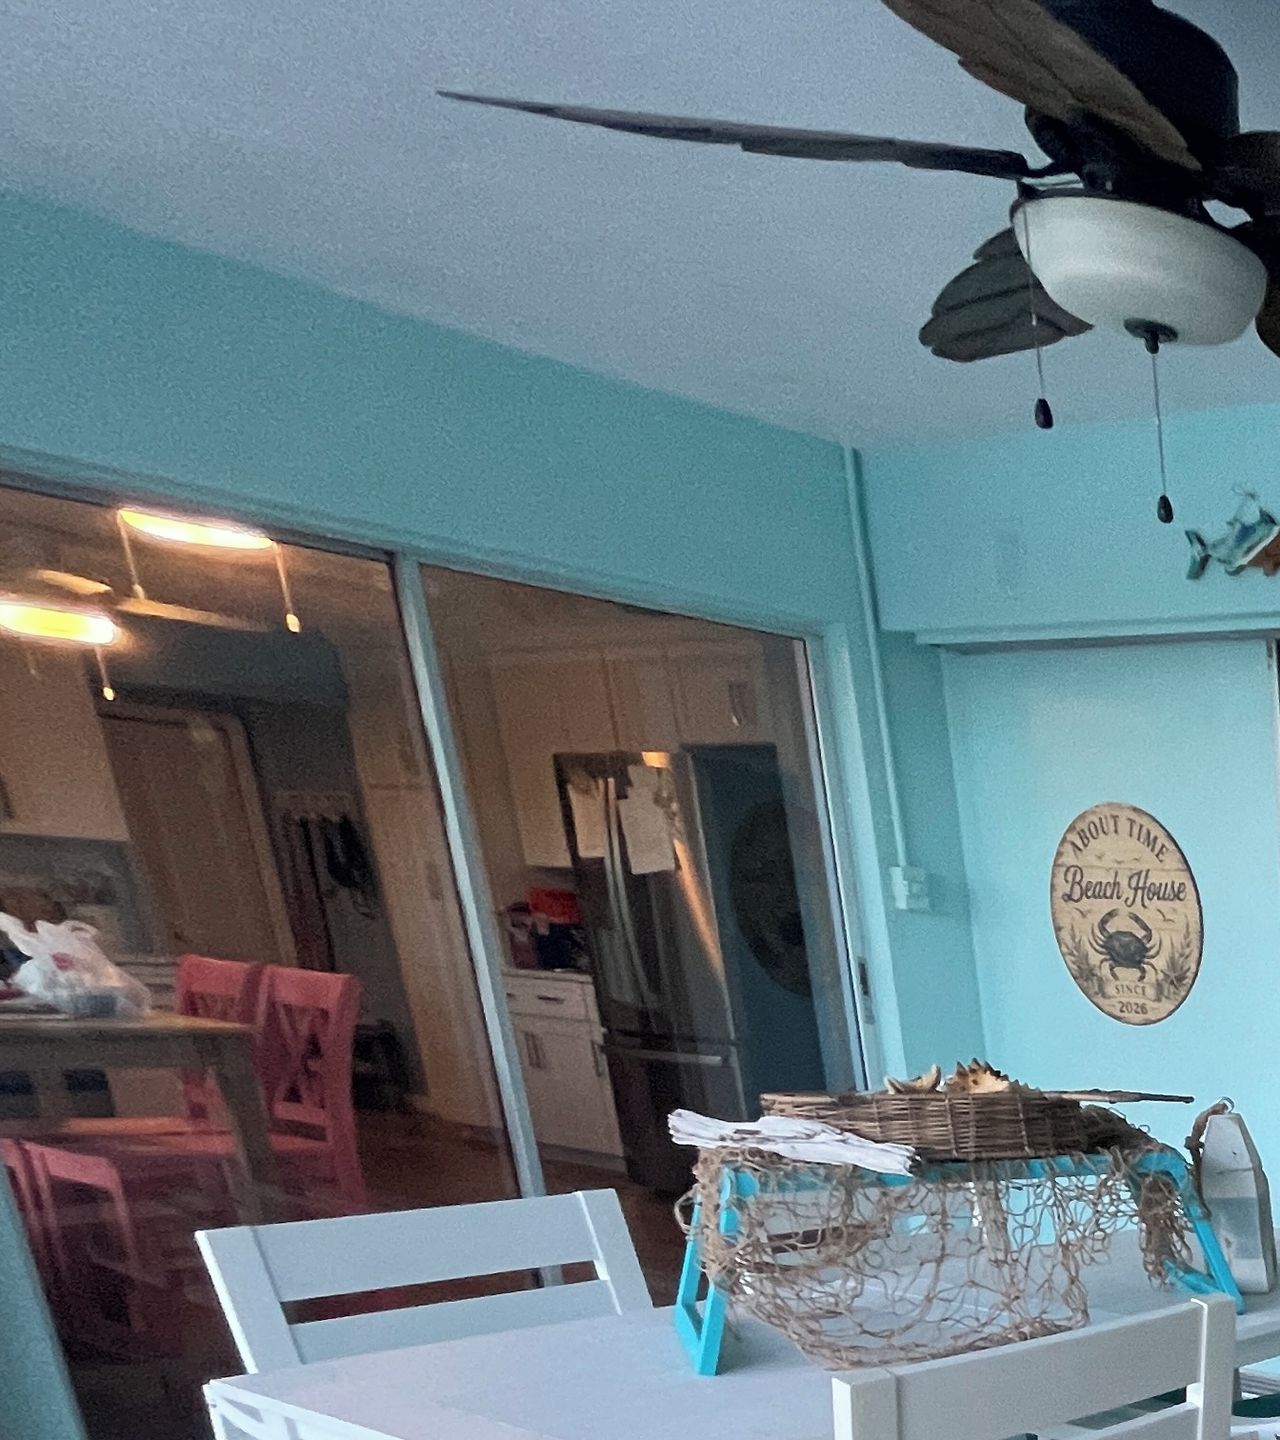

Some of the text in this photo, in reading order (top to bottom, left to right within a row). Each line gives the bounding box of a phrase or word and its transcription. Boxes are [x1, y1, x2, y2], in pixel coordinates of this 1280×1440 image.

[1069, 813, 1169, 862] ABOUT TIME
[1061, 865, 1186, 909] Beach House
